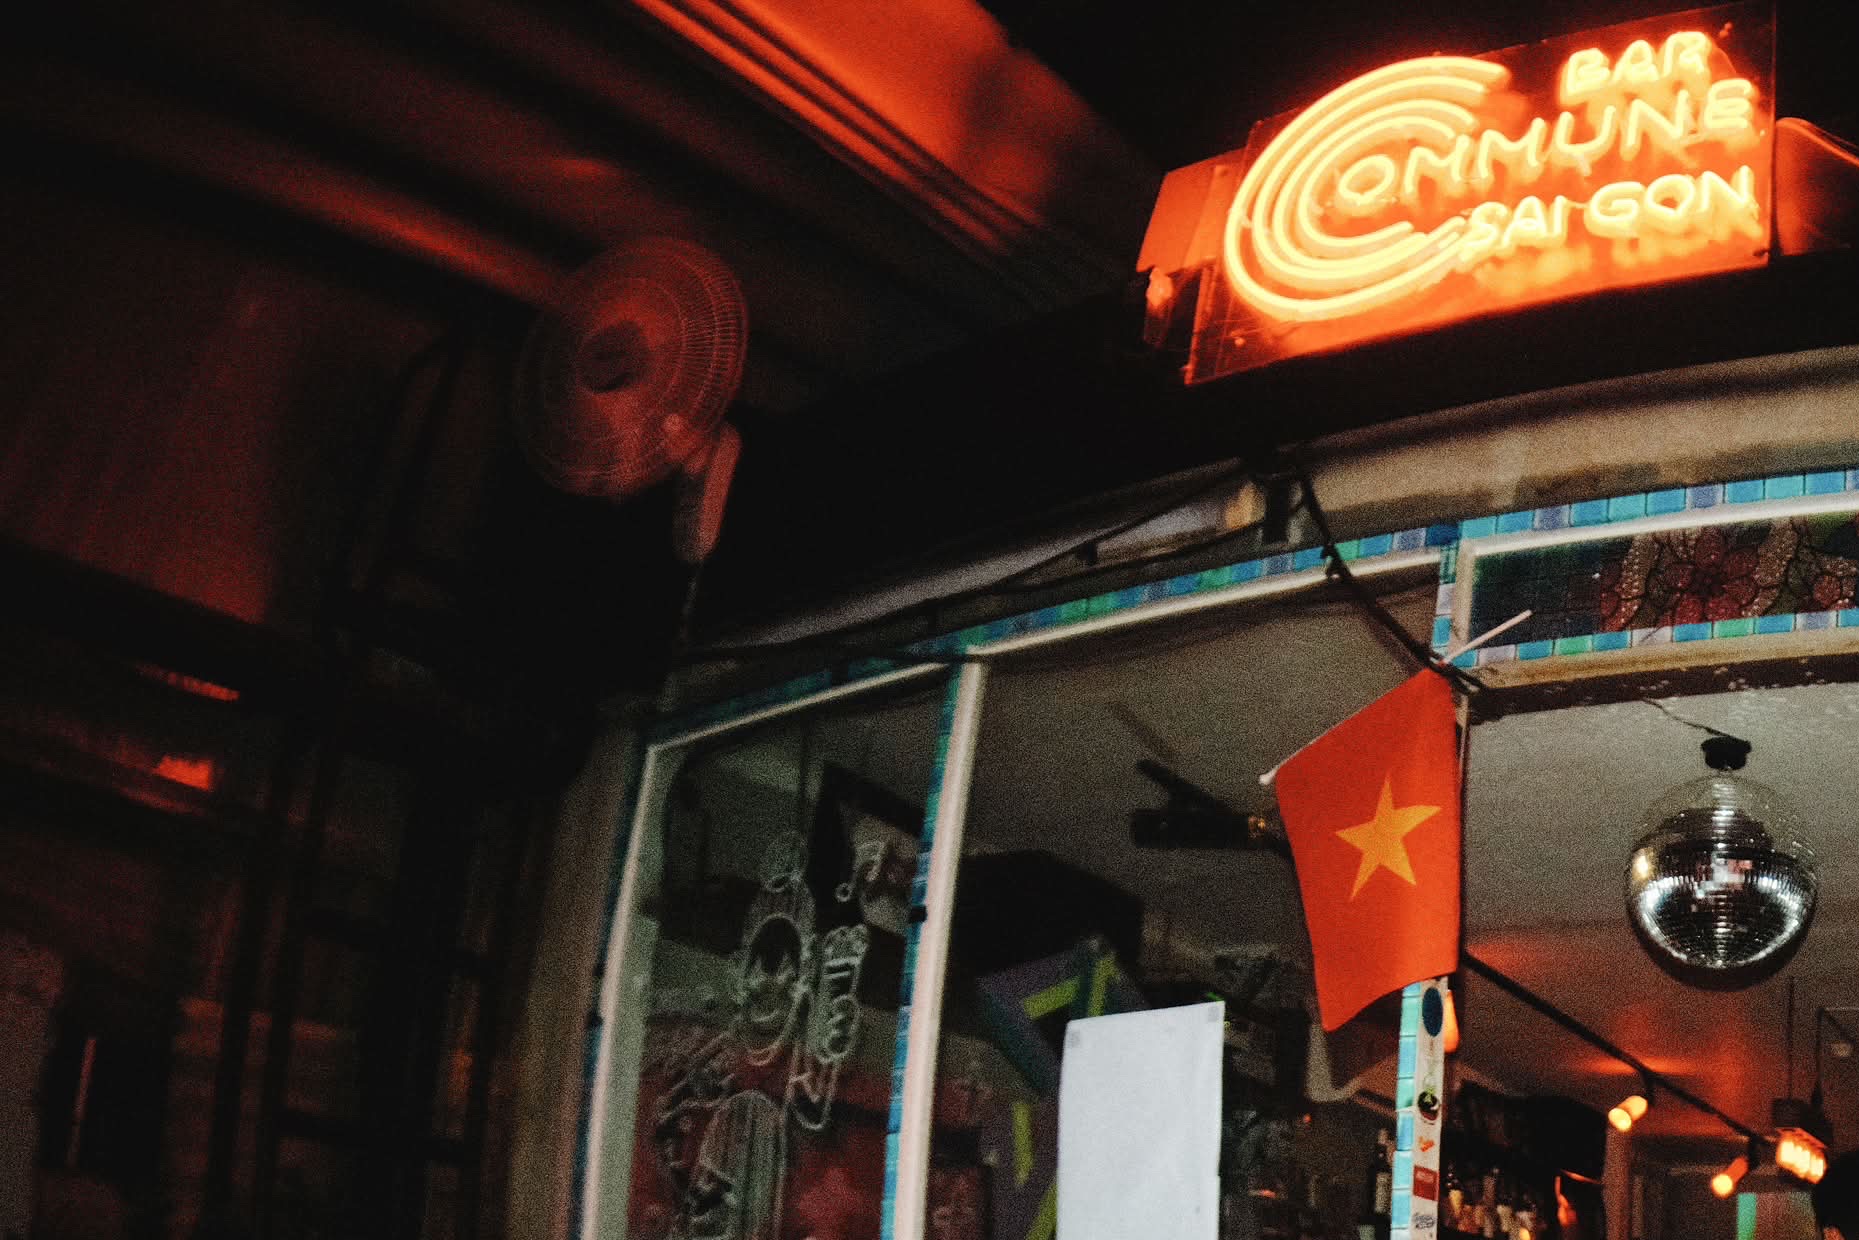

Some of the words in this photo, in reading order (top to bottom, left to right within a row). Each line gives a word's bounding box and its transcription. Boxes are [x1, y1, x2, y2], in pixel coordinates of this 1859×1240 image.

[1561, 29, 1714, 100] BAR
[1224, 55, 1756, 322] COMMUNE
[1455, 163, 1758, 266] SAIGON
